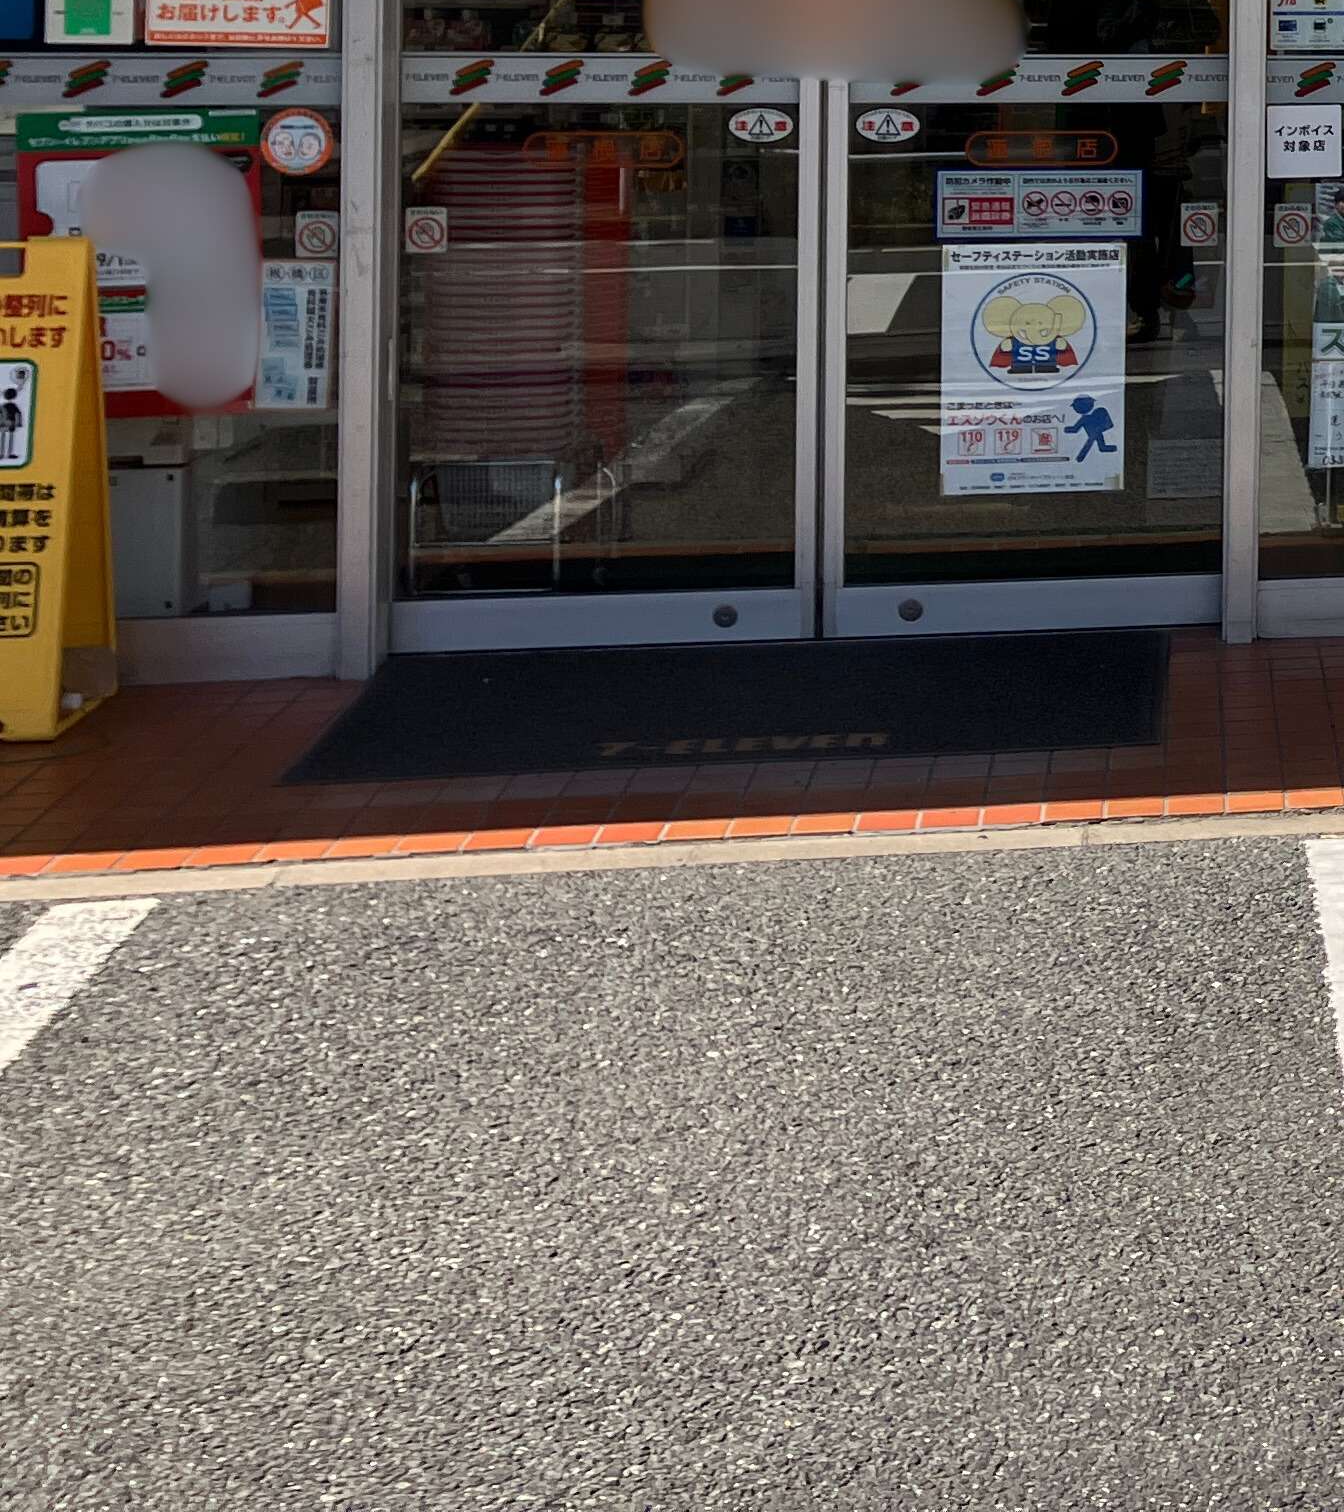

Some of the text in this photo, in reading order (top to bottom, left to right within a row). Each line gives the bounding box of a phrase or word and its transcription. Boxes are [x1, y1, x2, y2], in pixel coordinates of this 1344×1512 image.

[1274, 125, 1335, 137] インボイス
[1283, 140, 1327, 152] 対象店
[950, 249, 1120, 264] セーフティステーション活動実施店
[997, 277, 1072, 295] SAFETY STATION
[0, 294, 68, 318] 整列に
[1016, 346, 1051, 362] SS
[959, 429, 1020, 443] 110 119
